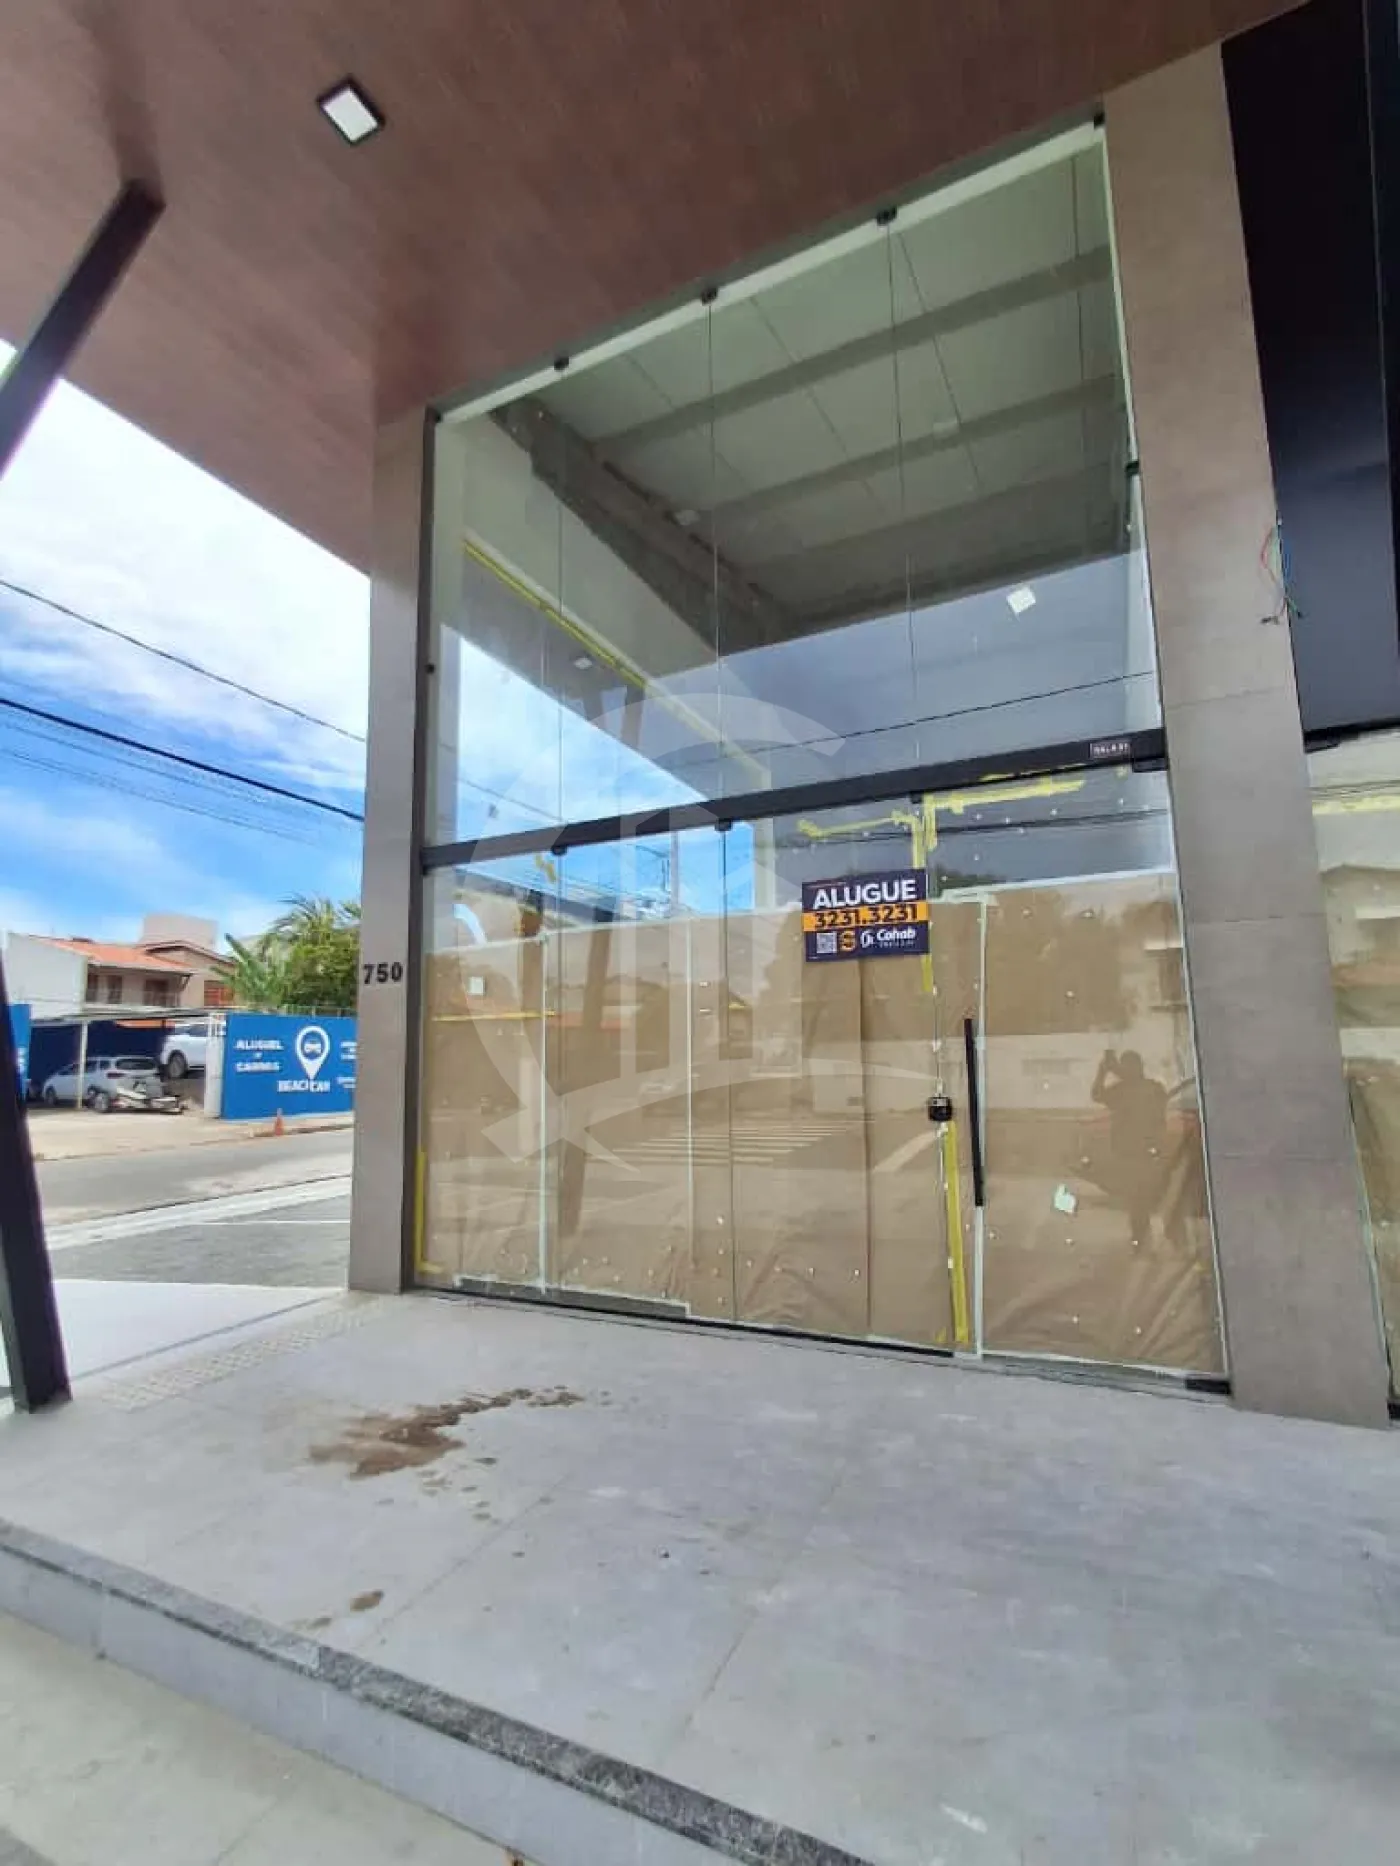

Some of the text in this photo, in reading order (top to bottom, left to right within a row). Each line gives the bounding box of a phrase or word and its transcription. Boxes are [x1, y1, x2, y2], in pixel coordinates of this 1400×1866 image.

[812, 879, 918, 910] ALUGUE
[814, 903, 918, 928] 3231.3231
[876, 926, 916, 941] Cohab
[364, 961, 403, 985] 750
